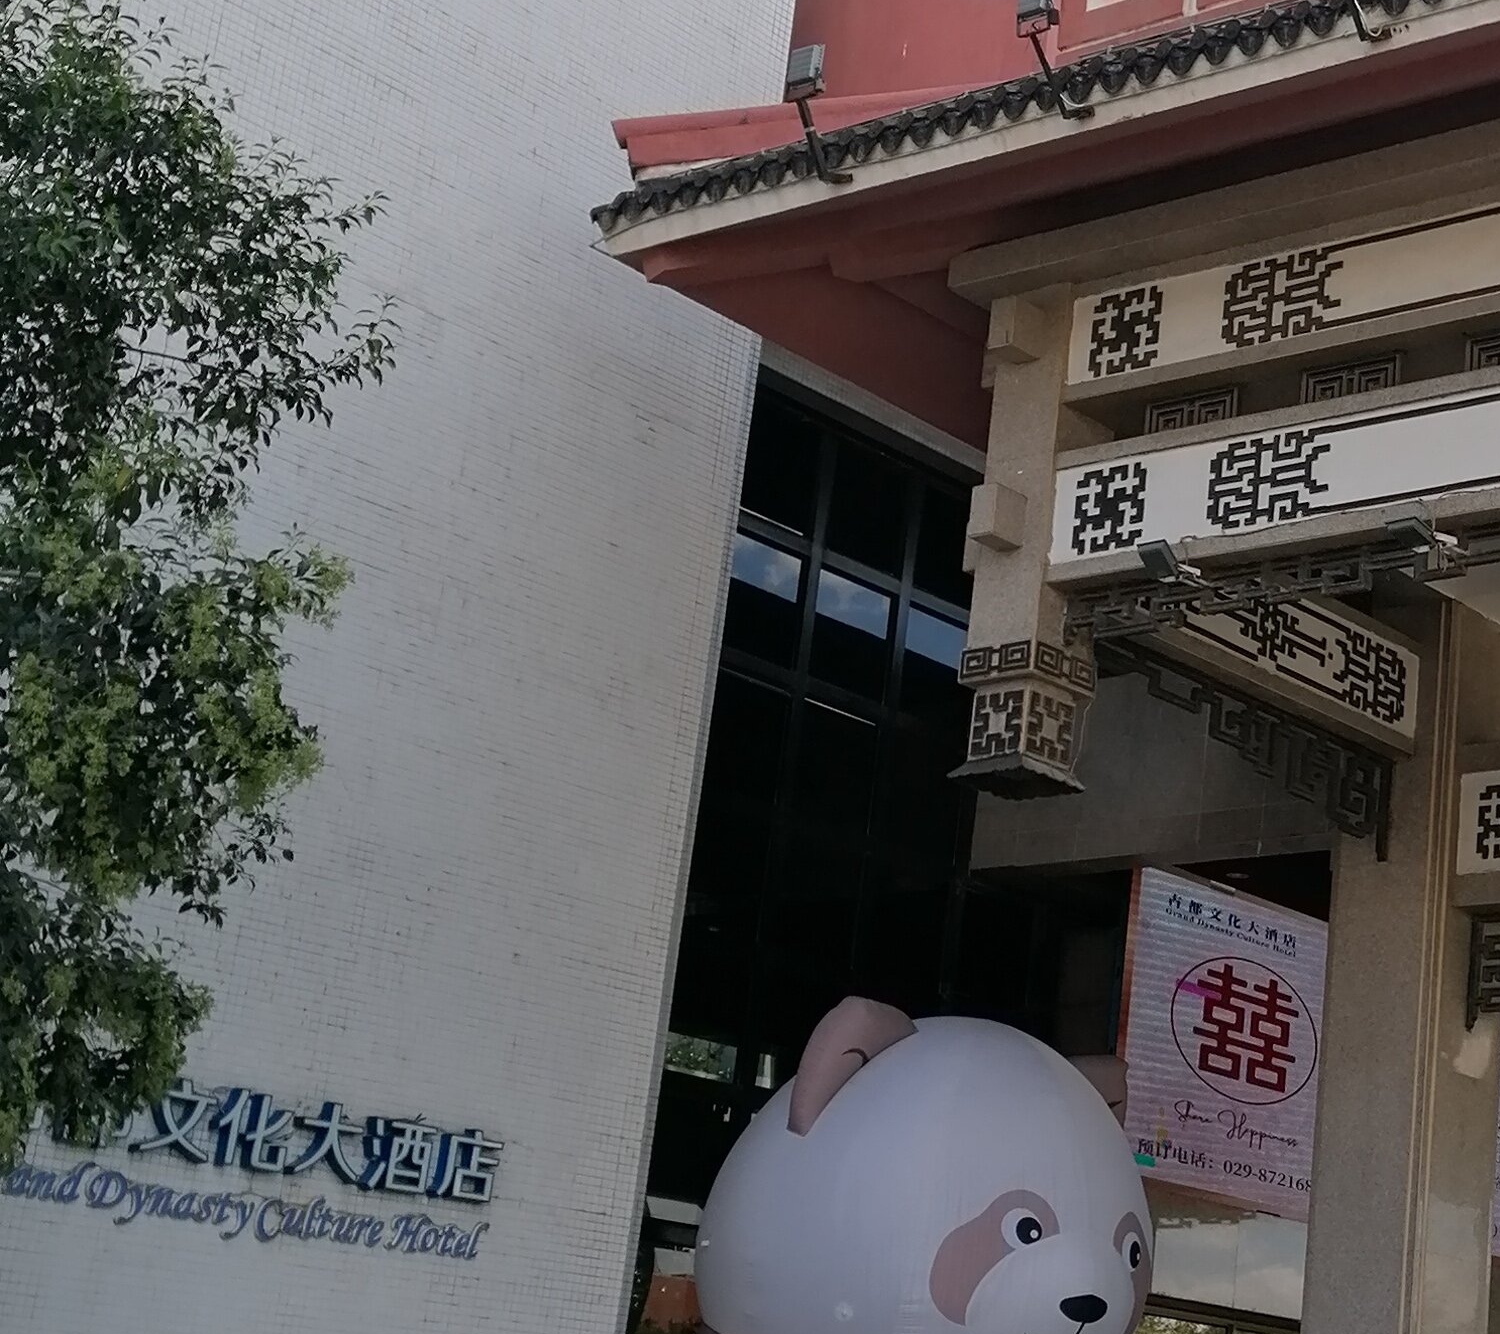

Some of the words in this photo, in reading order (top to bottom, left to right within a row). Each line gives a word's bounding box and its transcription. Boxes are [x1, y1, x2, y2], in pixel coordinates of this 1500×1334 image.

[28, 1078, 504, 1204] 文化大酒店
[4, 1162, 99, 1204] and
[86, 1167, 260, 1241] Dynasty
[252, 1195, 385, 1248] Culture
[384, 1214, 490, 1260] Hotel
